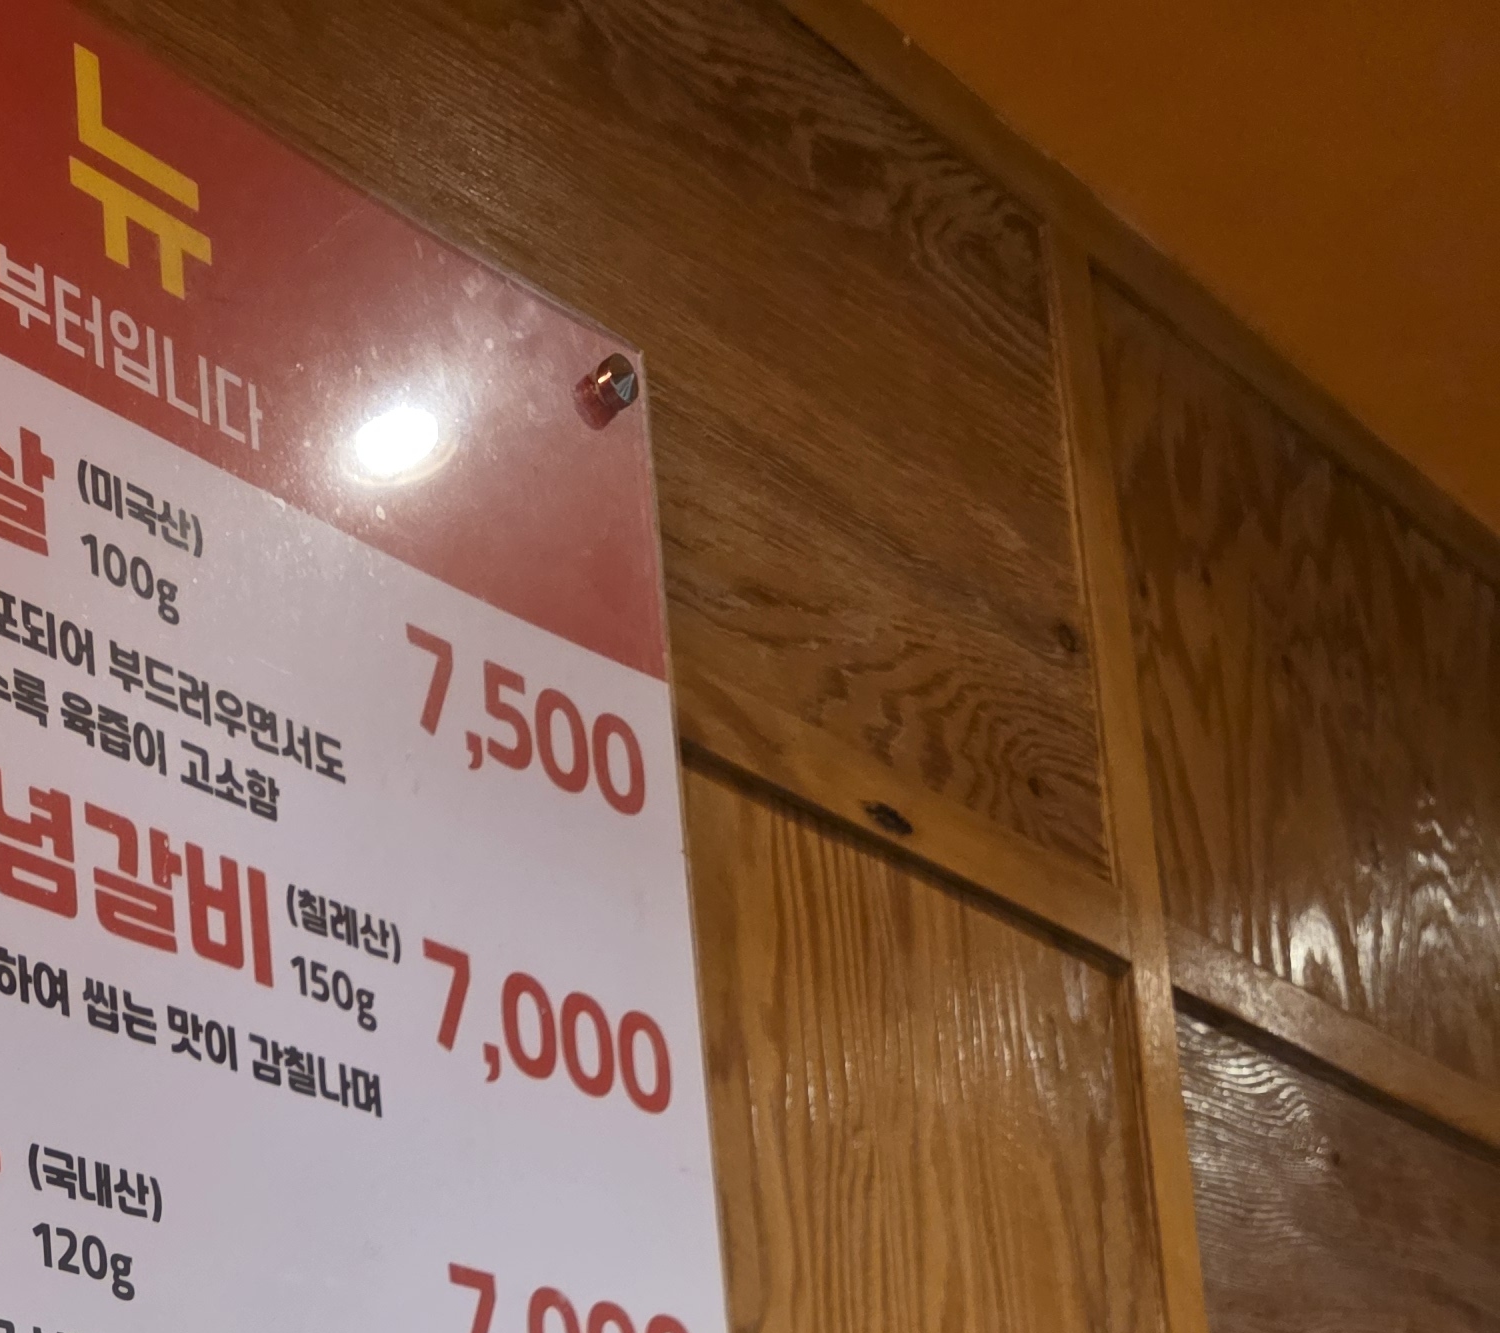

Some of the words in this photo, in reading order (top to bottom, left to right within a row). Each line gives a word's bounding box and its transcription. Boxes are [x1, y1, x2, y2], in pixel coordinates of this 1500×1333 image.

[69, 42, 212, 299] 뉴
[77, 459, 203, 558] (미국산)
[81, 534, 179, 626] 100g
[61, 691, 167, 776] 육즙이
[180, 740, 280, 822] 고소함
[109, 640, 346, 784] 부드러우면서도
[406, 622, 645, 816] 7,500
[286, 884, 401, 964] (칠레산)
[83, 977, 157, 1045] 씹는
[167, 1005, 238, 1071] 맛이
[249, 1033, 382, 1118] 감칠나며
[290, 956, 377, 1032] 150g
[422, 938, 671, 1114] 7,000
[27, 1143, 162, 1222] (국내산)
[32, 1222, 136, 1301] 120g
